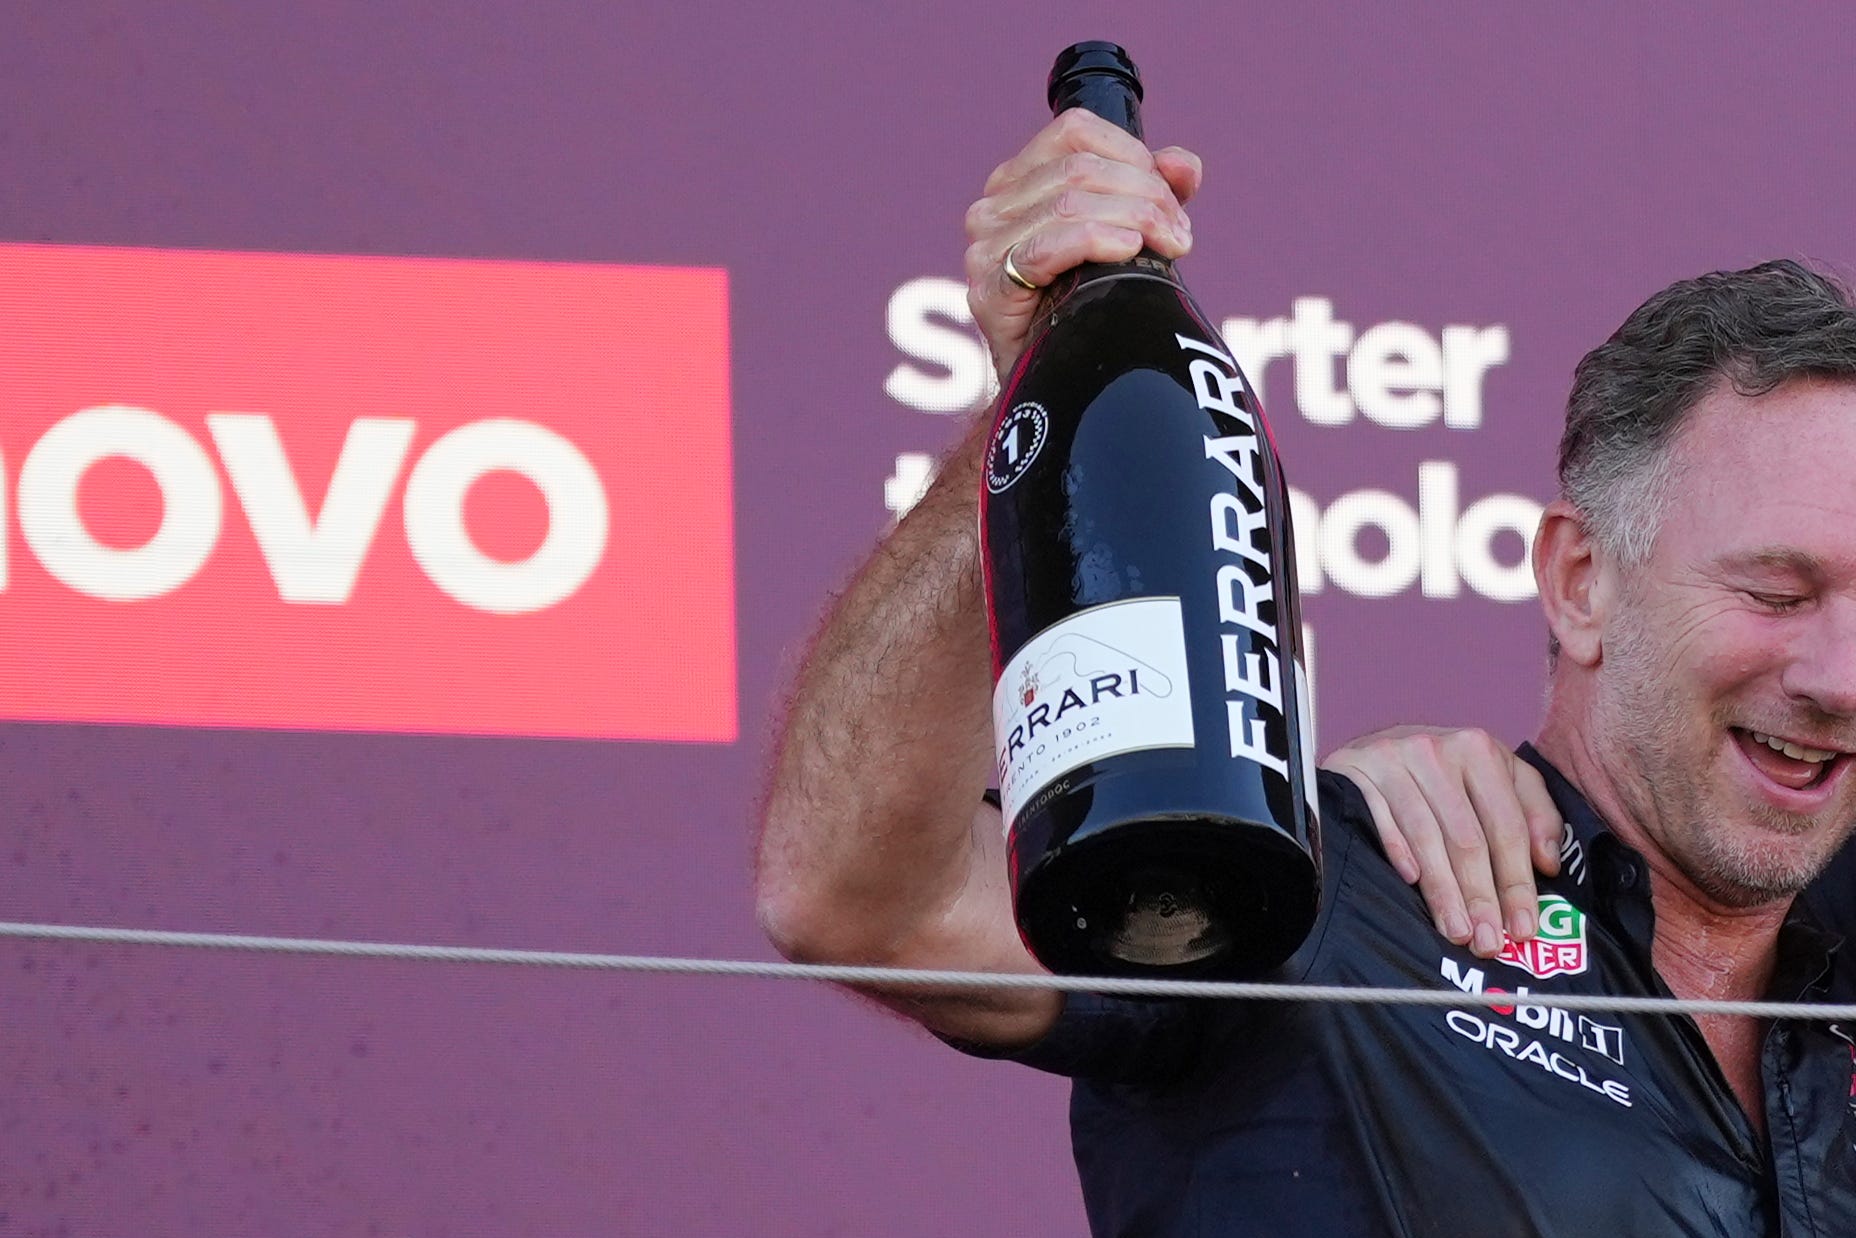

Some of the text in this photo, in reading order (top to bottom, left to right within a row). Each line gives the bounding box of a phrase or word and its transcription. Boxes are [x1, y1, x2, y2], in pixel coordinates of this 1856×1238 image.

[885, 275, 1509, 429] Srter
[0, 403, 609, 615] ovo
[1174, 331, 1290, 783] FERRARI
[998, 668, 1141, 783] ERRARI
[1054, 716, 1100, 742] 1902
[1445, 1010, 1633, 1108] ORACLE
